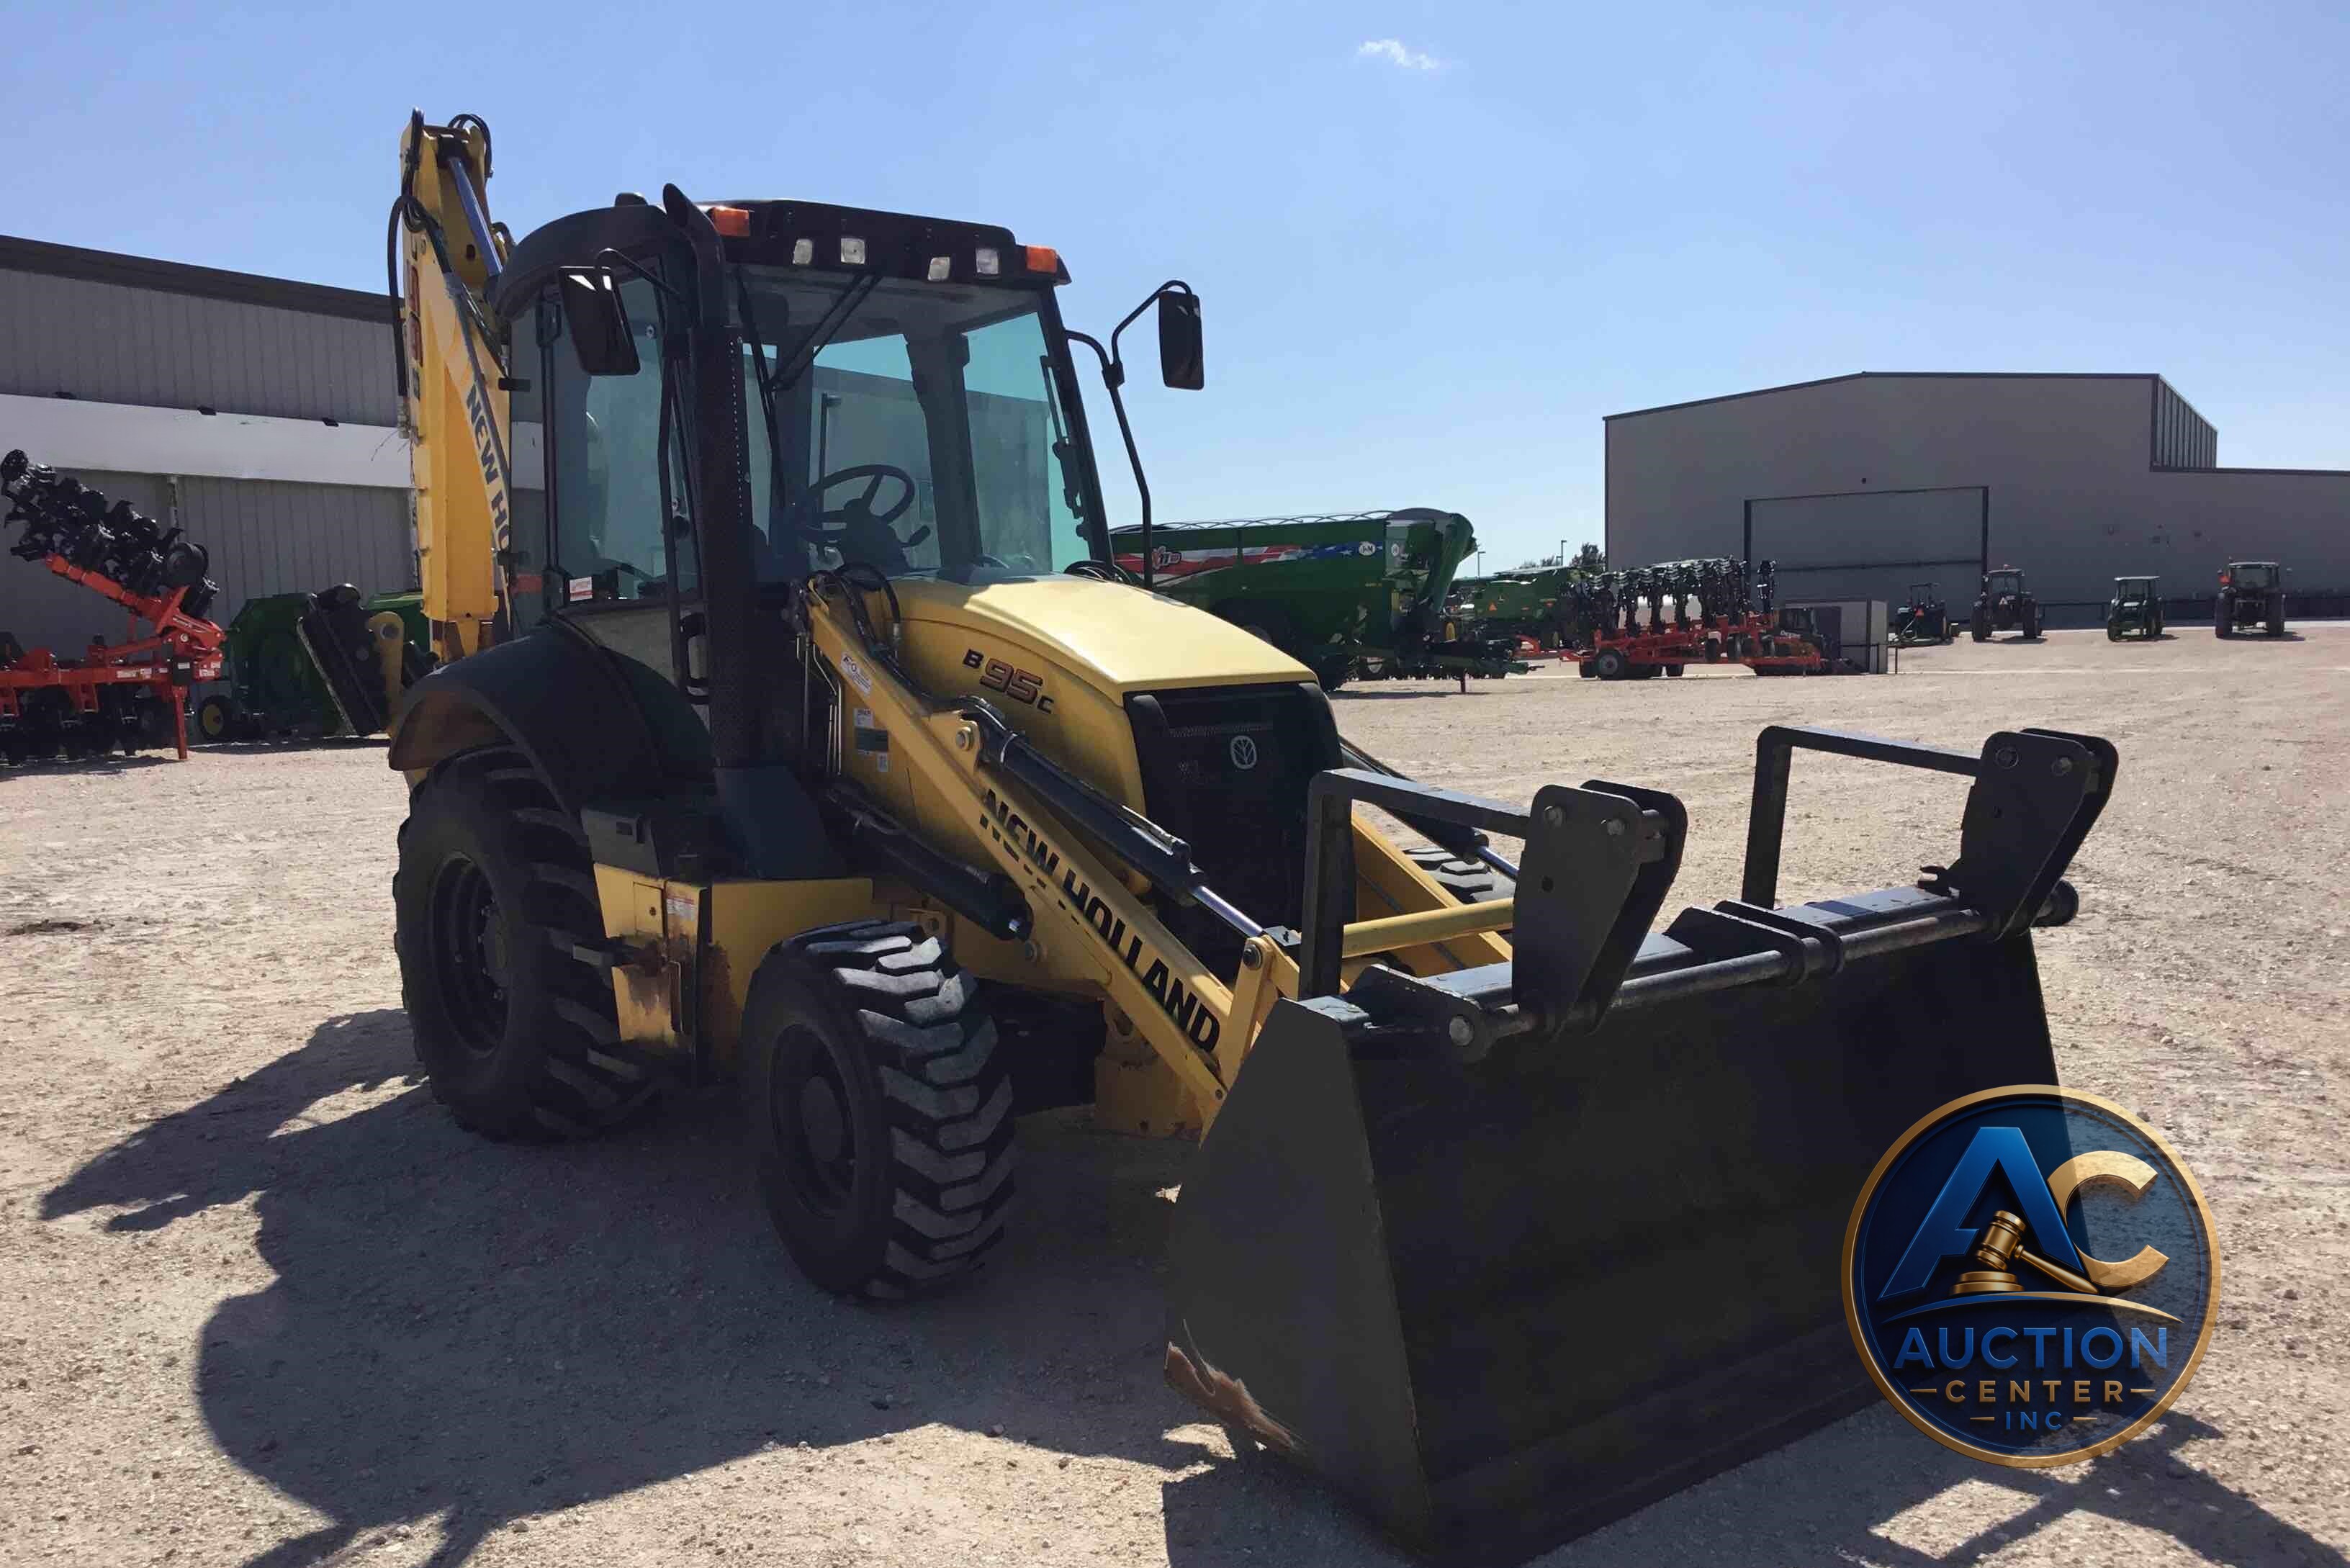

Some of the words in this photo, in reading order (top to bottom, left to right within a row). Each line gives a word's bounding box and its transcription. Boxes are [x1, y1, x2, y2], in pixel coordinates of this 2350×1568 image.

[467, 384, 499, 485] NEW
[980, 789, 1059, 889] NEW
[1058, 868, 1220, 1053] HOLLAND
